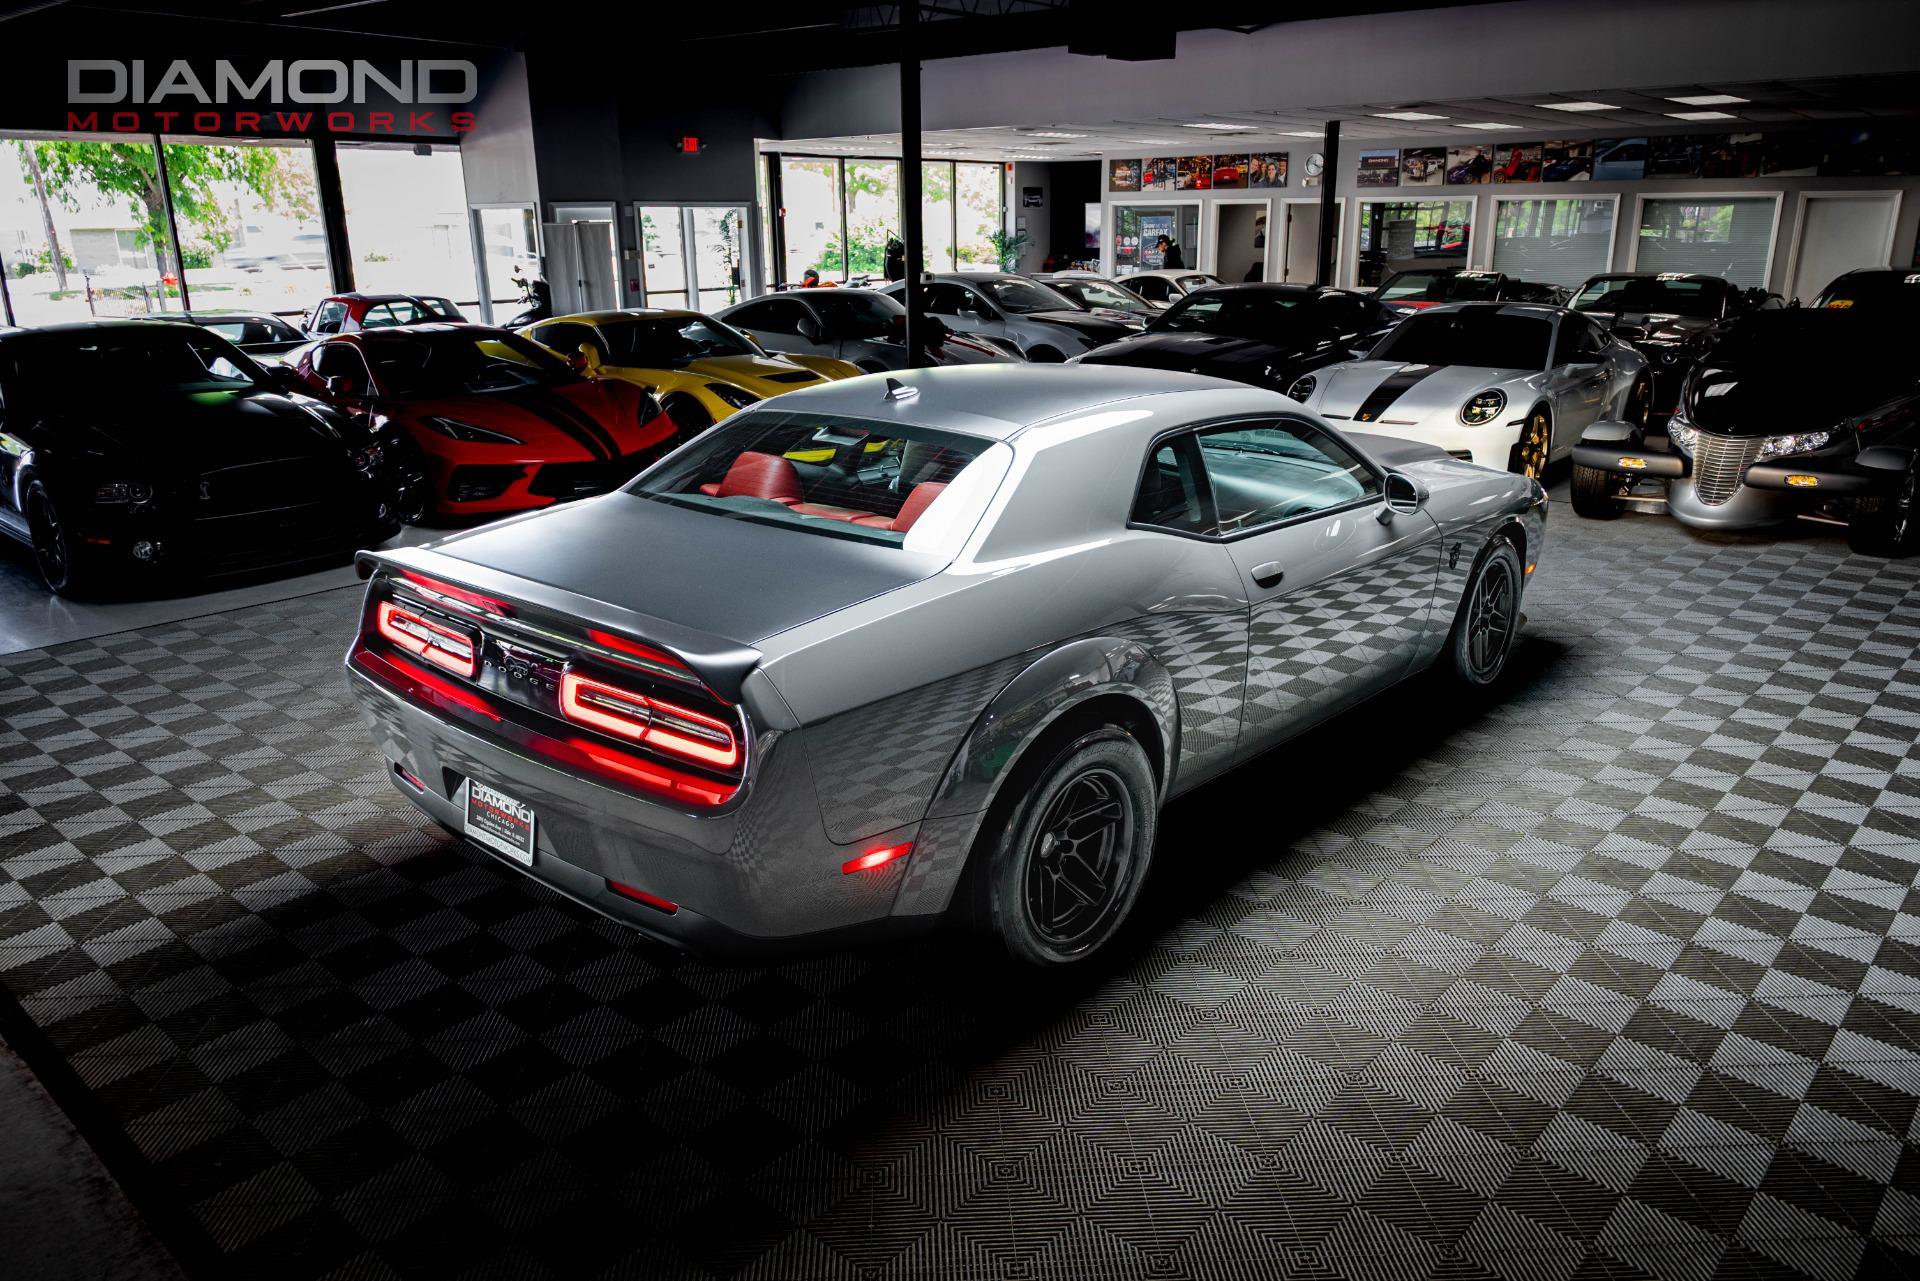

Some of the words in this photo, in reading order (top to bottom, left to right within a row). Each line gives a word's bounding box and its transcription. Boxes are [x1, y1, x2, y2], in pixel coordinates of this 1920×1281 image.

[1143, 228, 1169, 237] CARFAX
[484, 660, 554, 691] DODGE
[472, 786, 531, 823] DIAMOND
[486, 811, 515, 829] CHICAGO
